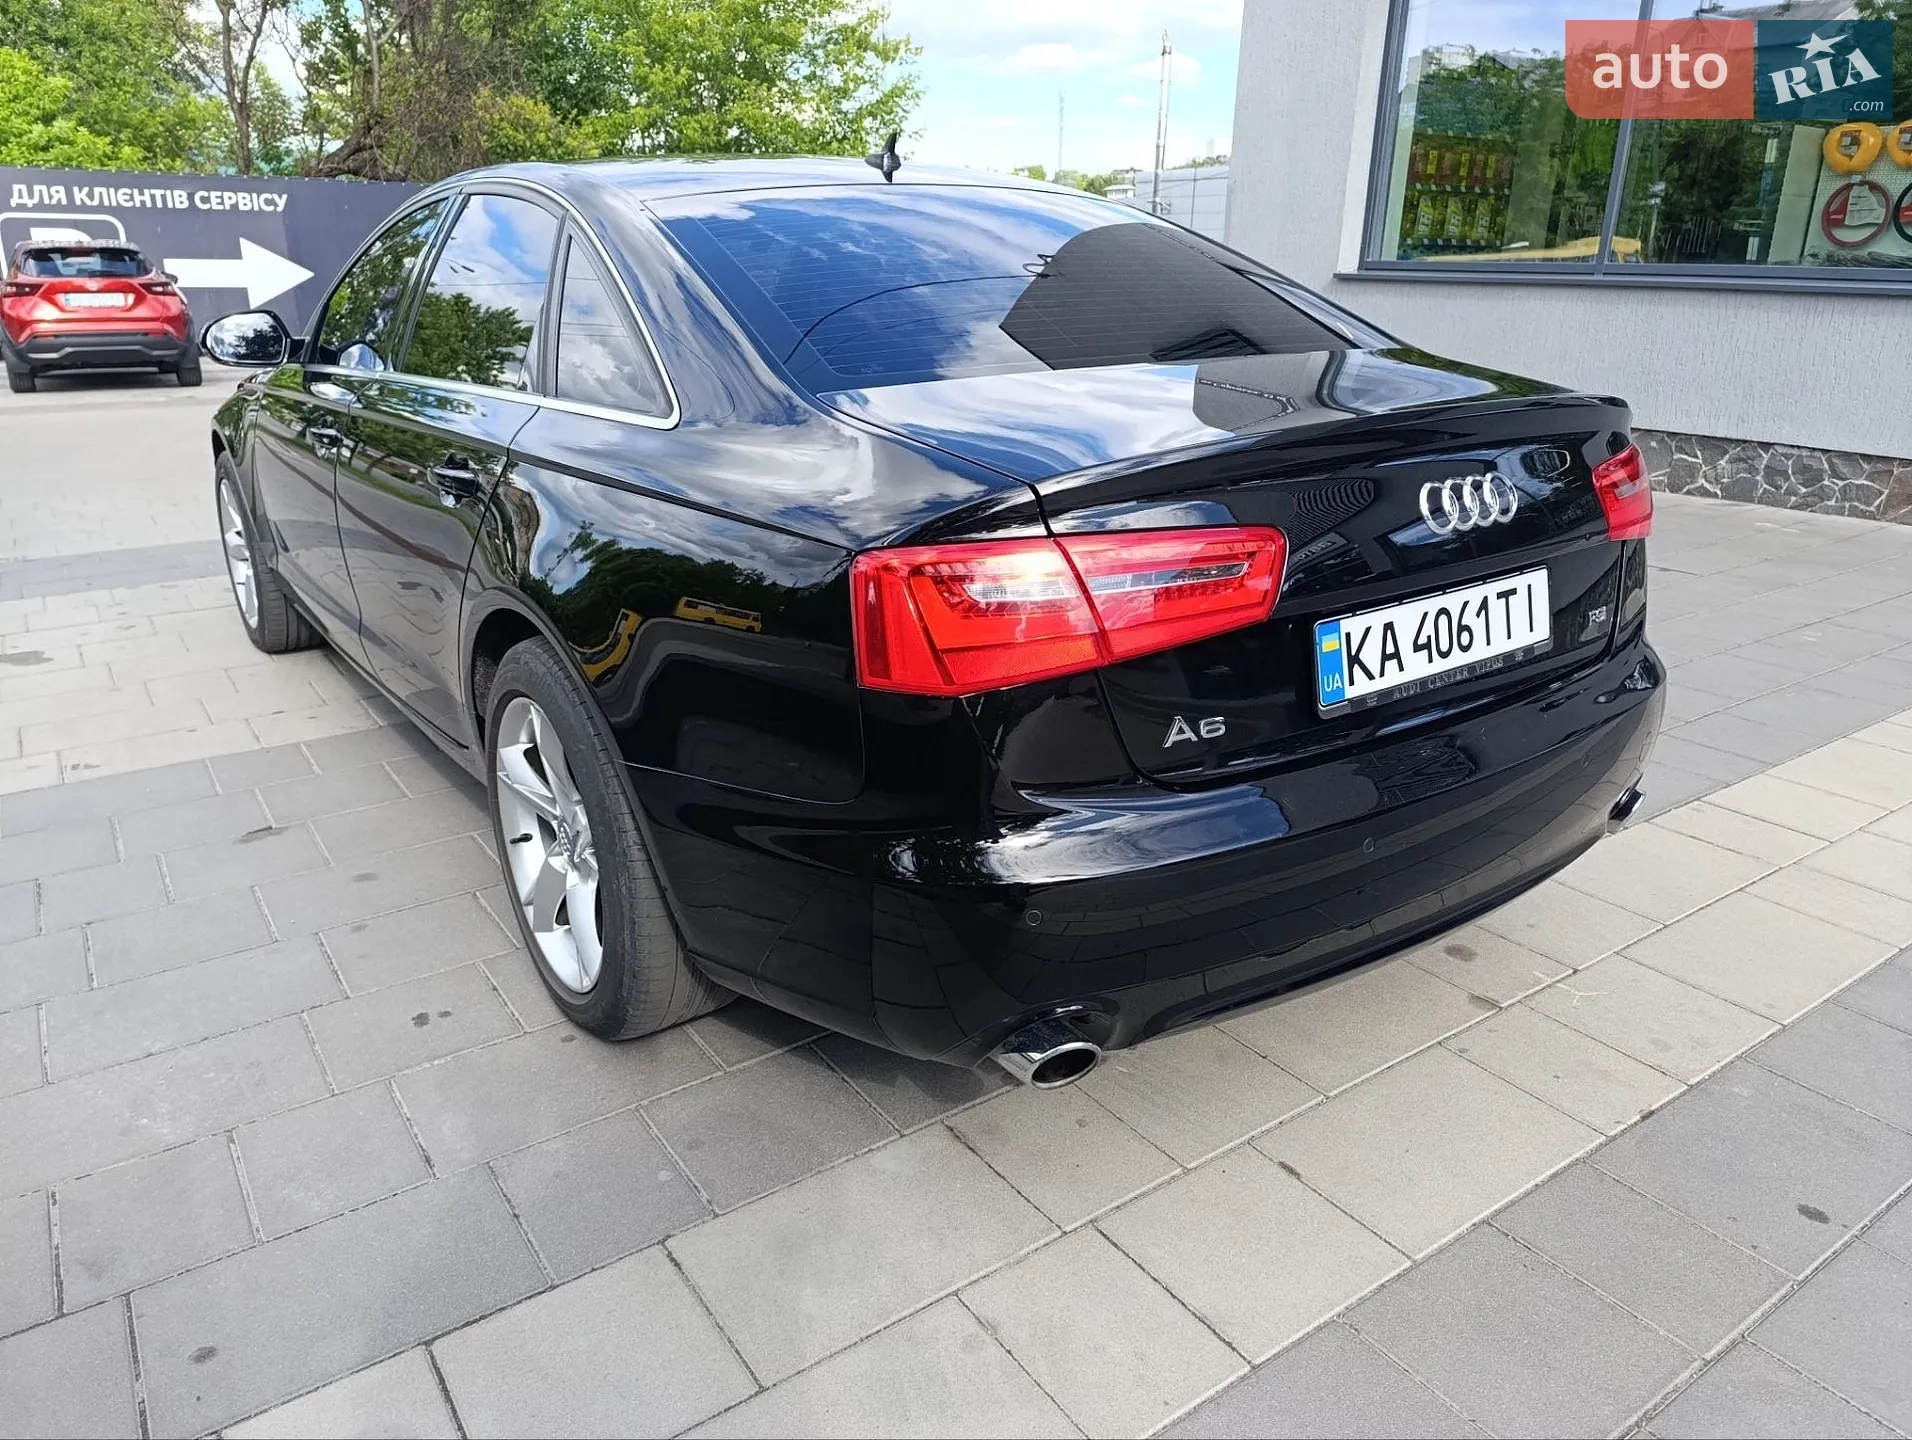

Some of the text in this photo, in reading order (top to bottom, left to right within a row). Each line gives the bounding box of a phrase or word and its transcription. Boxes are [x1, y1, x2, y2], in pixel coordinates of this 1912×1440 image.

[9, 184, 288, 212] ДЛЯ КЛІЄНТІВ СЕРВІСУ
[1323, 672, 1343, 692] UA
[1392, 682, 1421, 700] AUDI
[1163, 715, 1226, 748] A6
